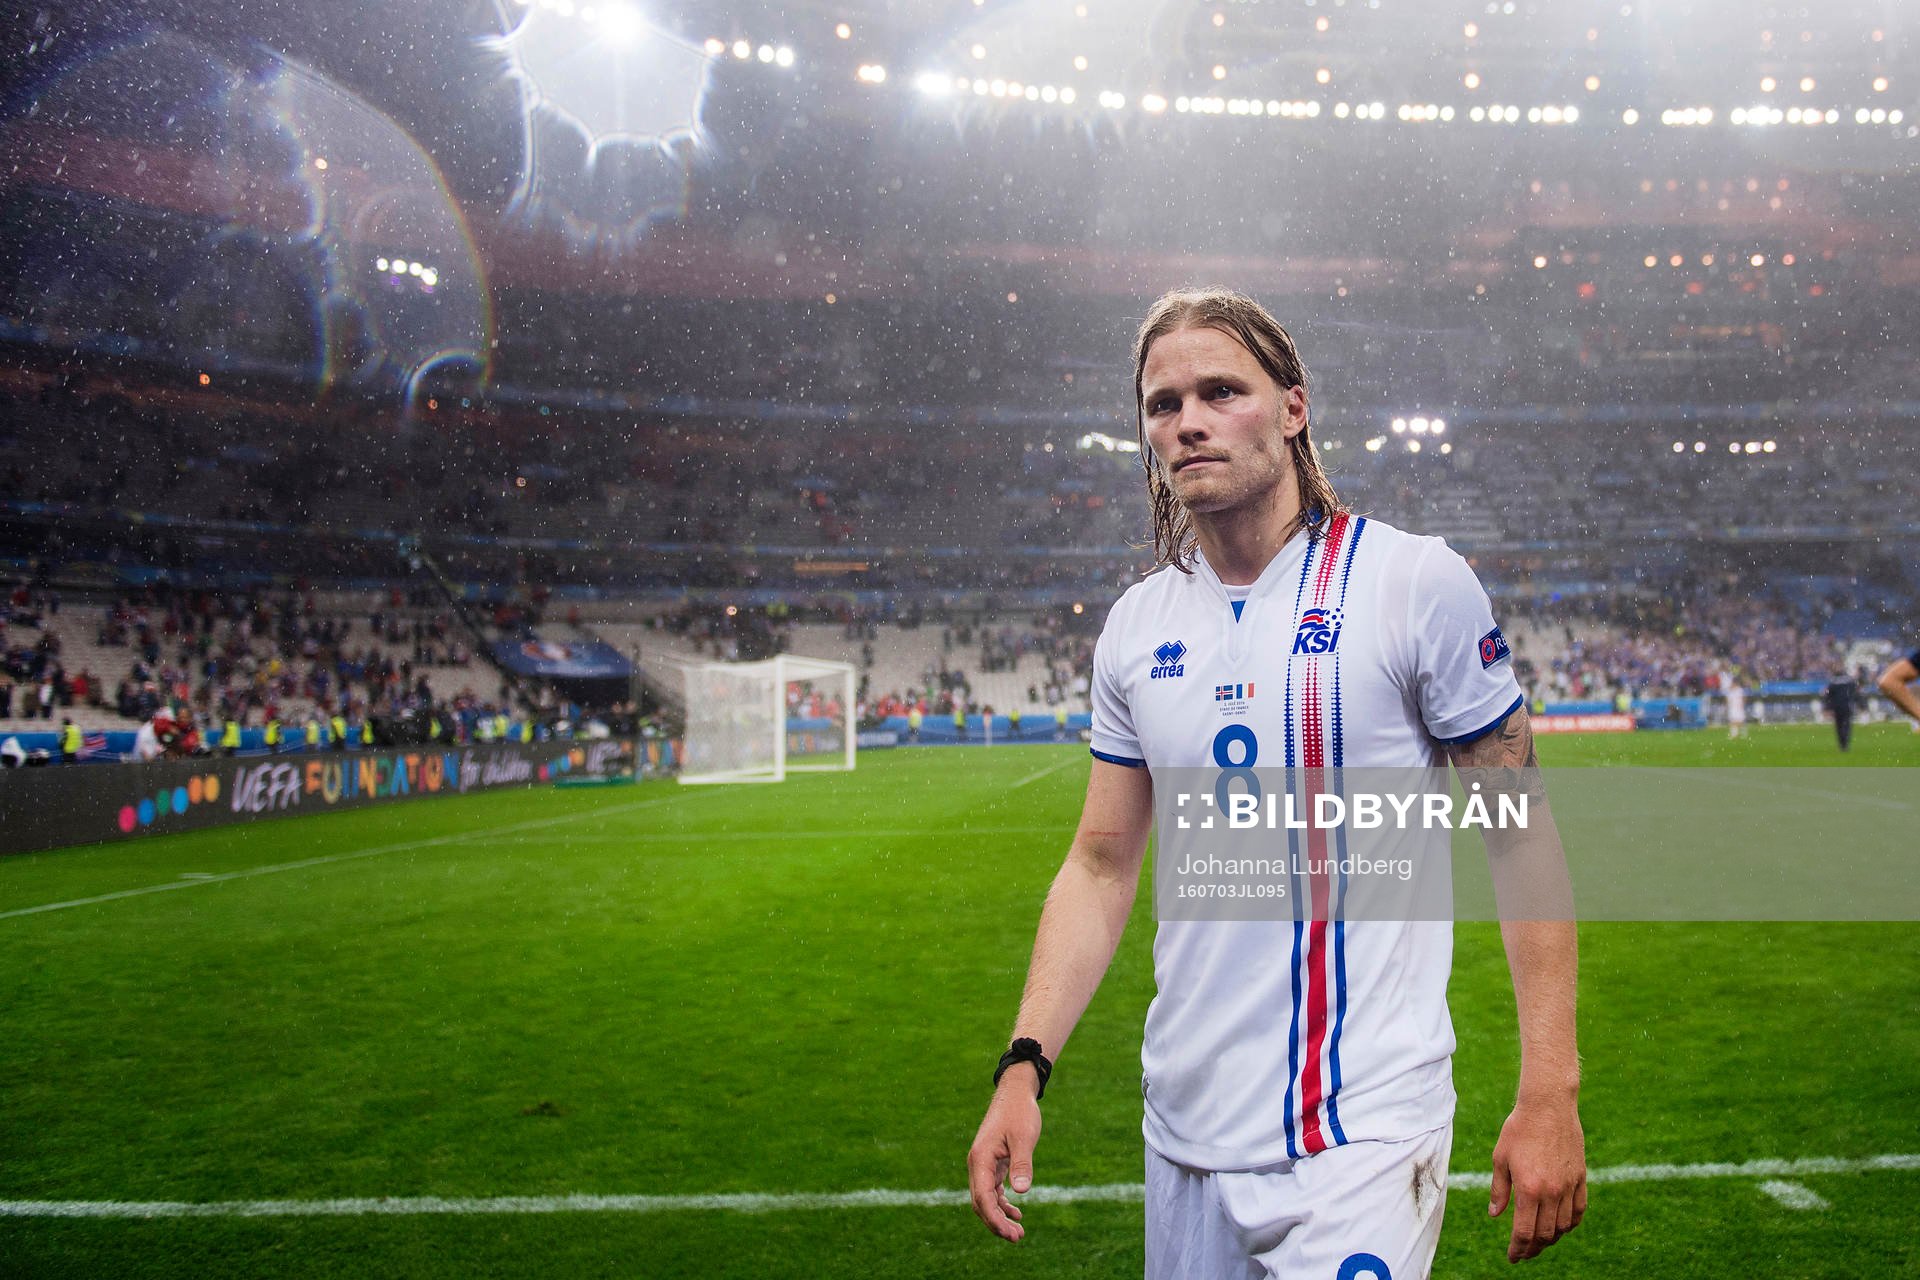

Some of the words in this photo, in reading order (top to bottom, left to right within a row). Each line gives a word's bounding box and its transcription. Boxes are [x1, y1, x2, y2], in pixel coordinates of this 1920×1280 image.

[1291, 630, 1341, 655] KSI
[231, 762, 302, 813] UEFA
[1213, 724, 1261, 820] 8
